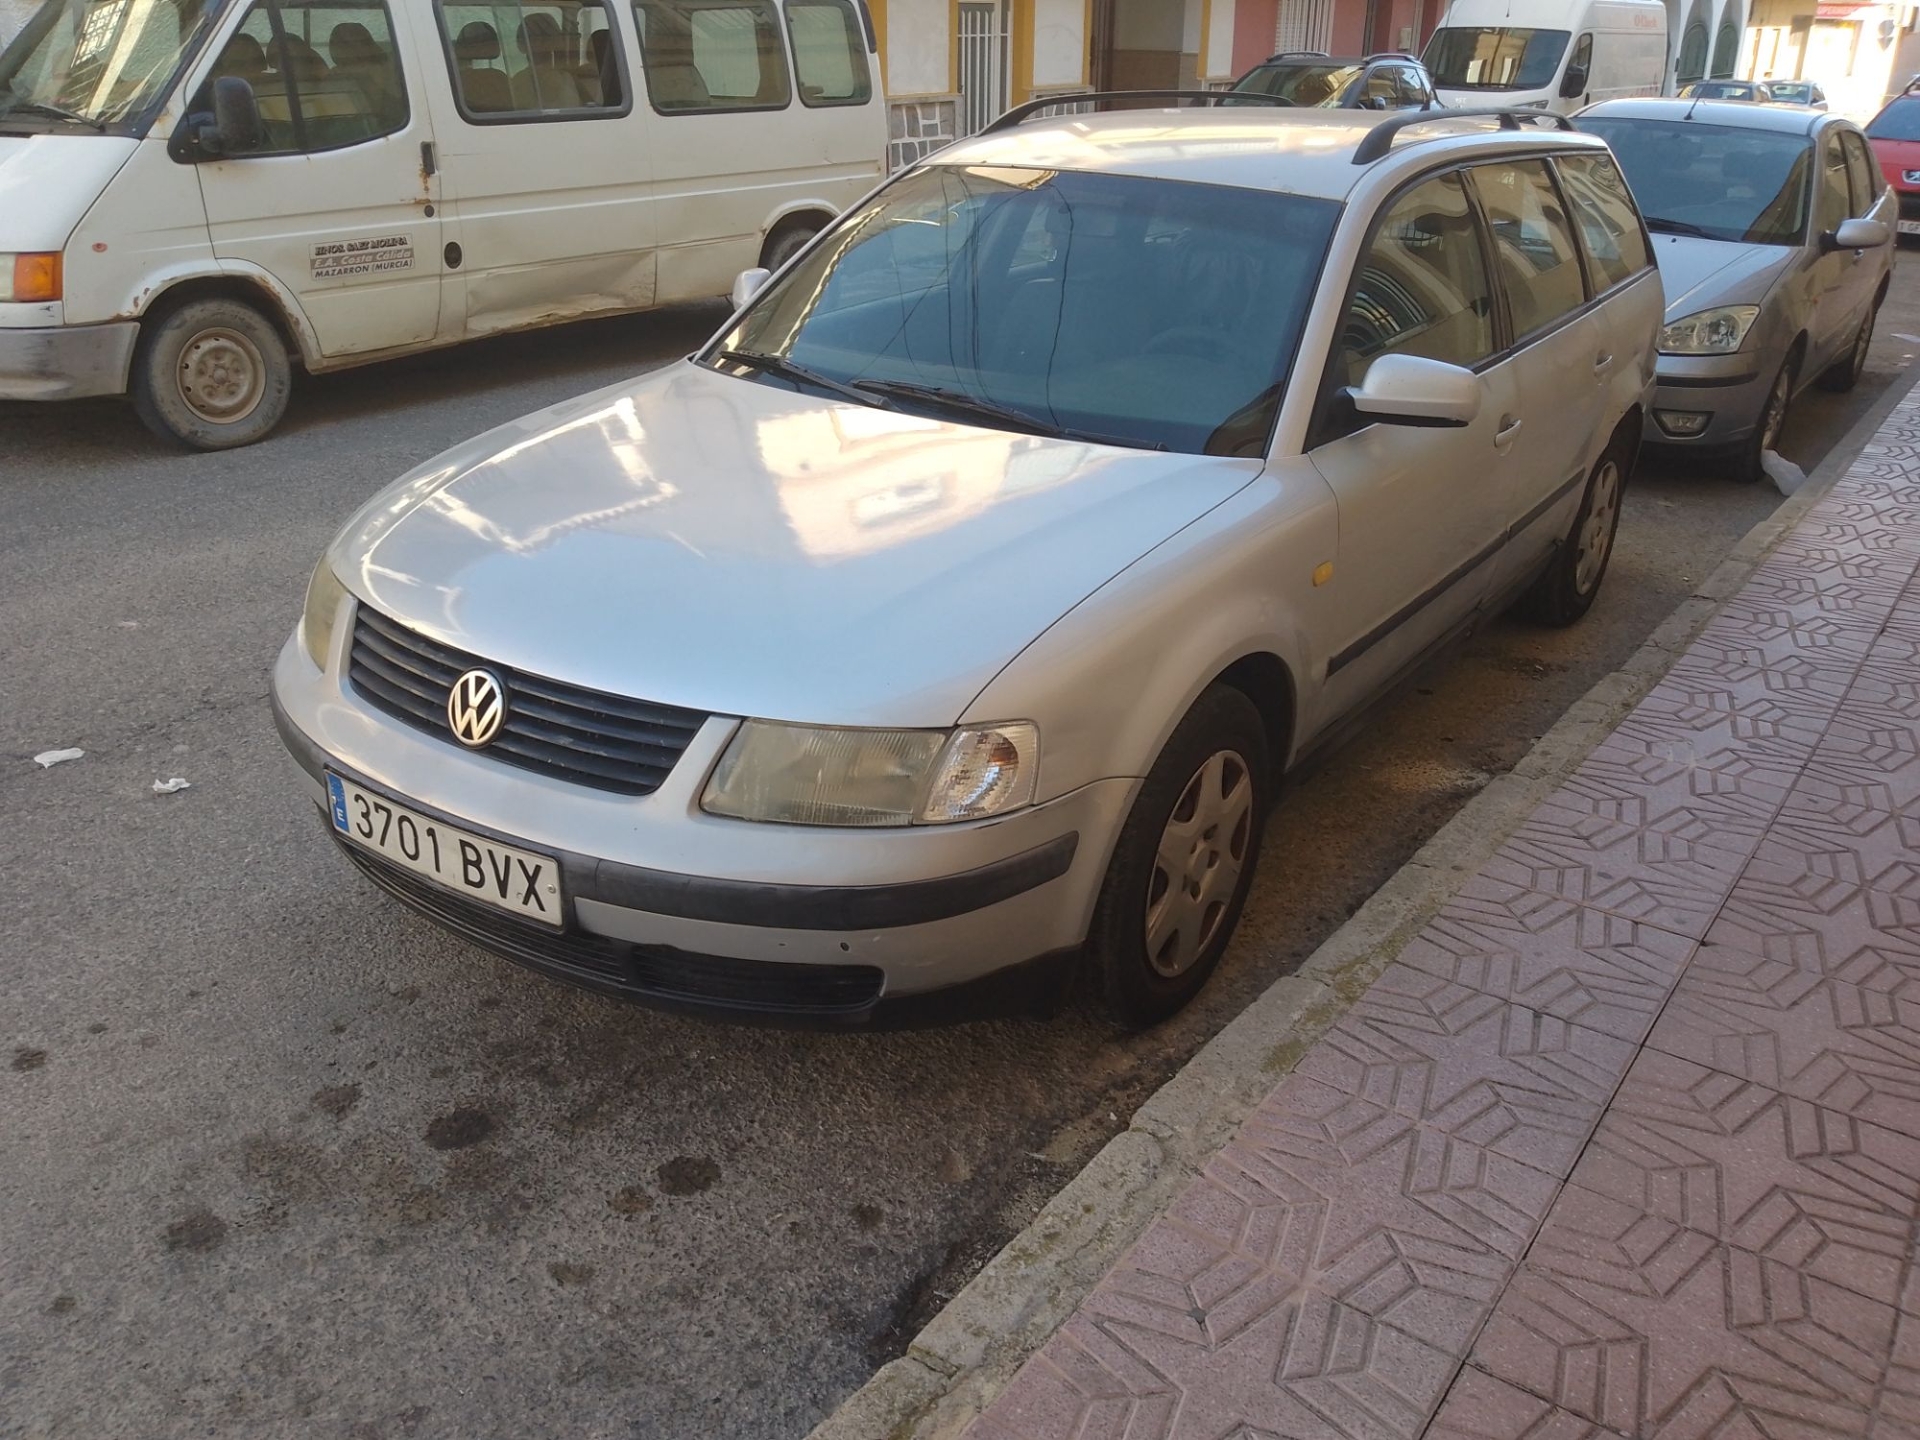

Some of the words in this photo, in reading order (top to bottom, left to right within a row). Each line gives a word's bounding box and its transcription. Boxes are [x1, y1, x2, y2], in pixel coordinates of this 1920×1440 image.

[341, 254, 373, 266] Costa
[376, 249, 411, 260] Cálida
[373, 260, 412, 272] (MURCIA)
[336, 806, 345, 822] E
[354, 793, 442, 874] 3701
[458, 838, 546, 912] BVX
